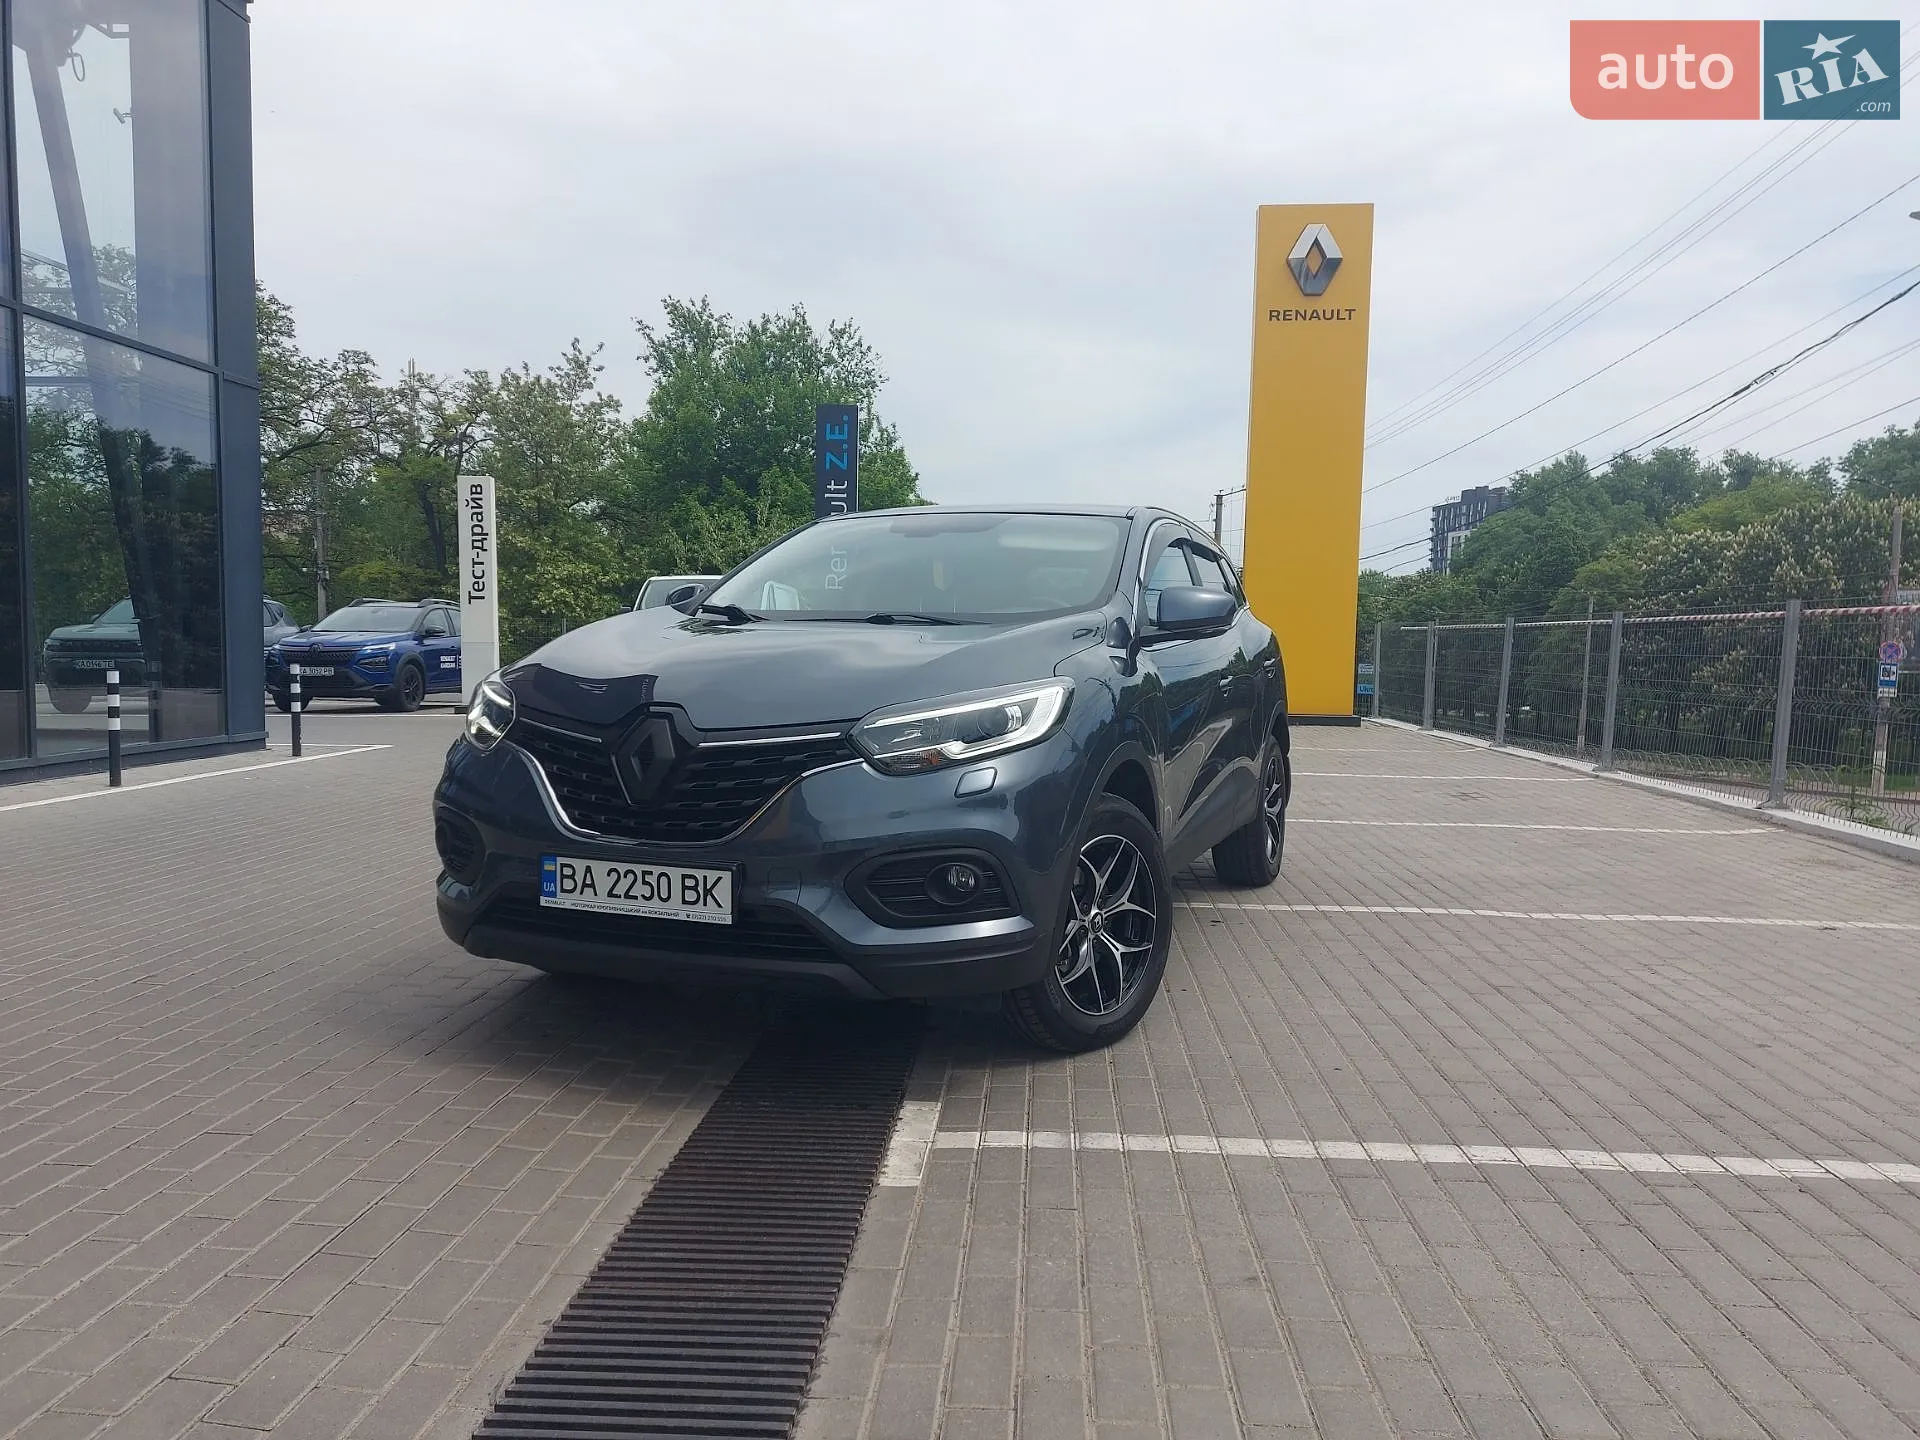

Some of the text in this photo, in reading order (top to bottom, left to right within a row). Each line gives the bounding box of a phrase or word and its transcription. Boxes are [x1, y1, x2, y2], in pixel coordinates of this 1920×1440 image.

[1269, 308, 1356, 321] RENAULT
[825, 415, 849, 471] Z.E.
[465, 483, 488, 604] Тест-драйв
[543, 882, 555, 892] UA
[560, 862, 723, 909] BA 2250 BK
